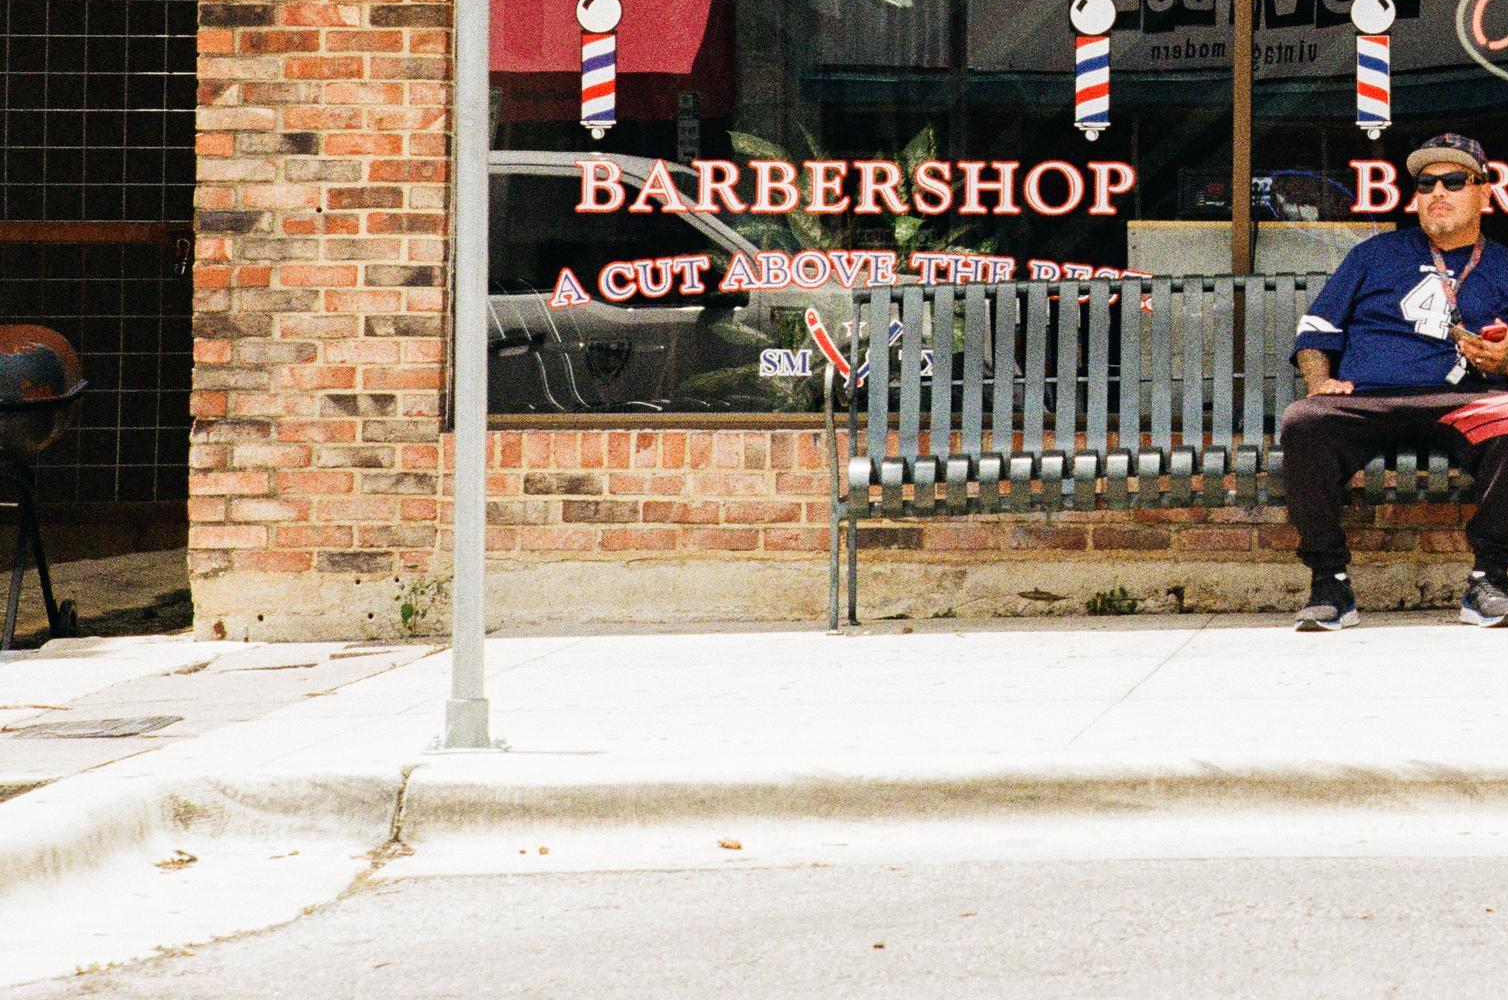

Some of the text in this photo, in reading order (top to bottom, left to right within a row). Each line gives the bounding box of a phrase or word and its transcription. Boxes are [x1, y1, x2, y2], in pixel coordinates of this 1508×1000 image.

[575, 158, 1136, 215] BARBERSHOP
[550, 249, 1016, 308] A CUT ABOVE THE
[1400, 273, 1457, 340] 4
[760, 348, 812, 377] SM
